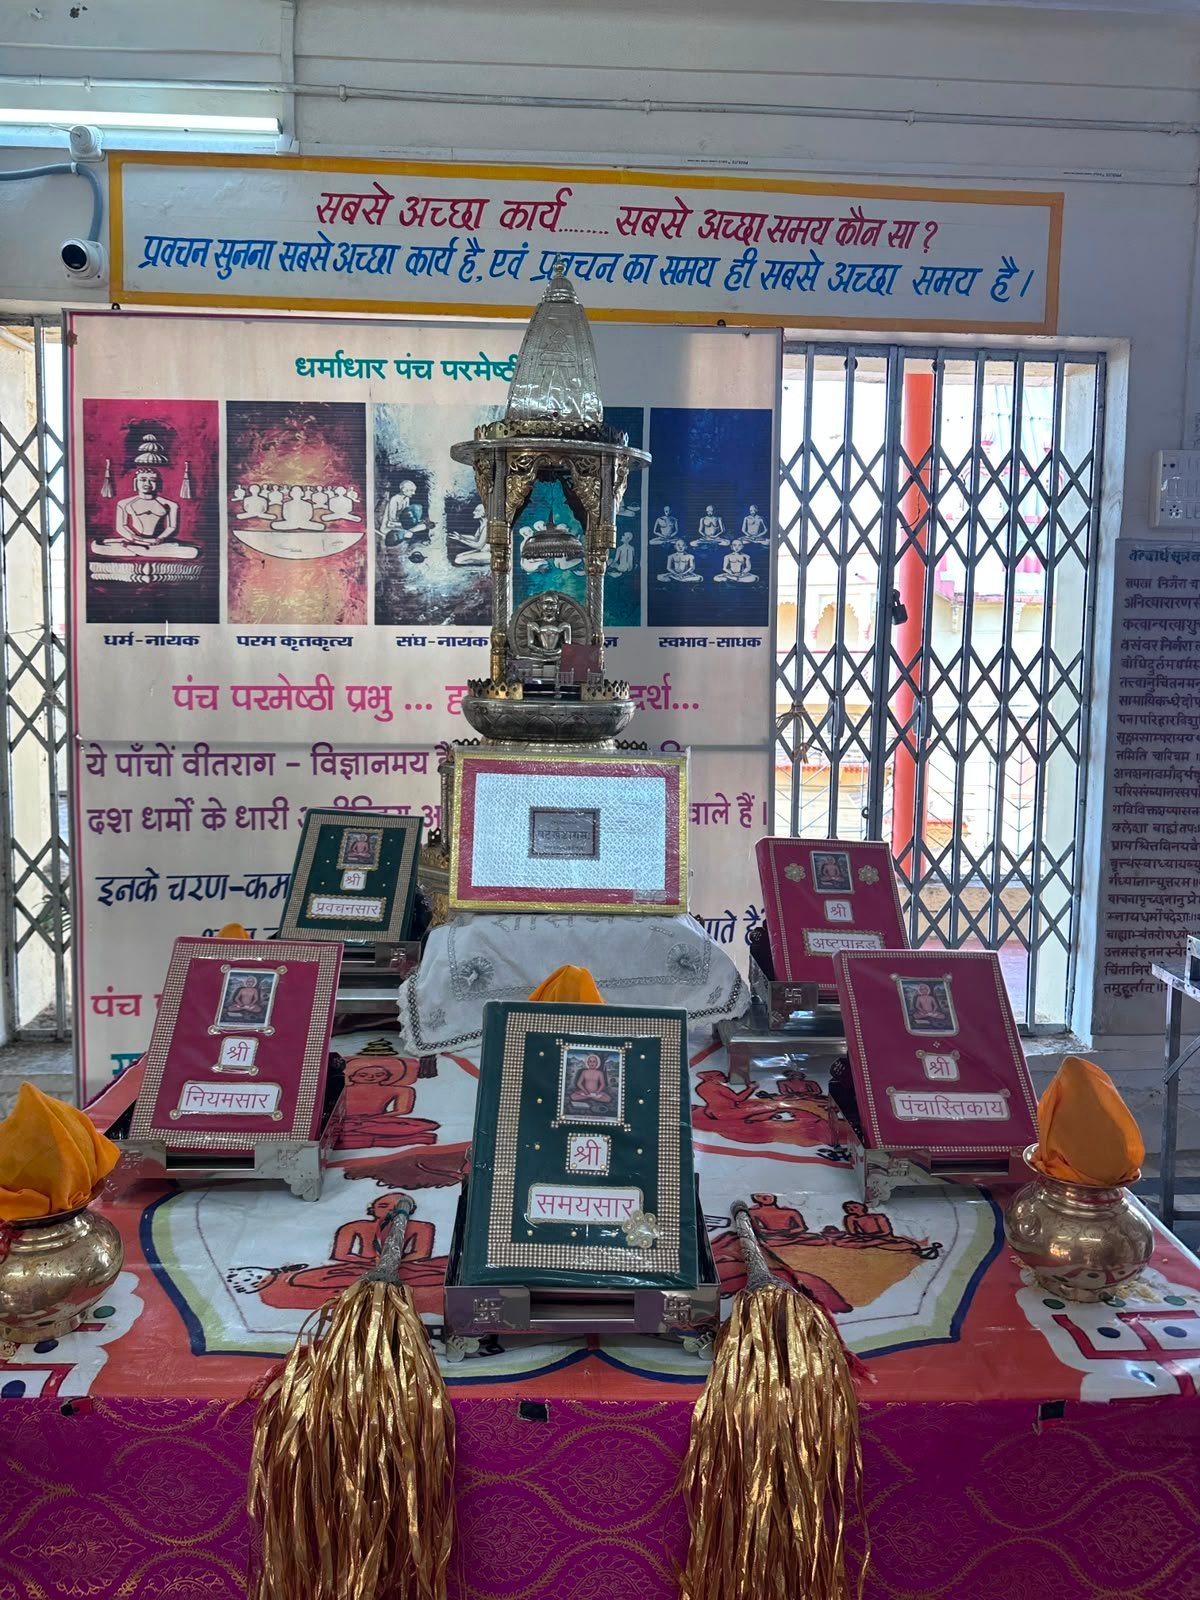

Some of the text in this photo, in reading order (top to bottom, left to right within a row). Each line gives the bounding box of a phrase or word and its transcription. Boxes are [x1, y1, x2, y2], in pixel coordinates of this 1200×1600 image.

[316, 181, 395, 226] सबसे
[399, 195, 491, 232] अच्छा
[615, 195, 694, 240] सबसे
[698, 208, 769, 246] अच्छा
[767, 214, 835, 247] समय
[836, 205, 888, 248] कौन
[137, 235, 214, 269] प्रवचन
[213, 238, 278, 281] सुनना
[278, 230, 337, 273] सबसे
[333, 242, 402, 275] अच्छा
[405, 237, 460, 277] कार्य
[489, 241, 530, 280] एवं
[622, 253, 658, 285] का
[659, 255, 721, 288] समय
[723, 246, 758, 292] ही
[760, 248, 825, 293] सबसे
[827, 261, 903, 296] अच्छा
[912, 265, 983, 297] समय
[294, 349, 389, 379] धर्माधार
[393, 352, 435, 380] पंच
[236, 635, 354, 652] परम कृतकृत्य
[171, 674, 219, 711] पंच
[230, 673, 335, 712] परमेष्ठी
[345, 685, 394, 723] प्रभु
[86, 742, 108, 778] ये
[115, 741, 176, 777] पाँचों
[182, 741, 277, 777] वीतराग
[310, 741, 430, 781] विज्ञानमय
[86, 807, 133, 835] दश
[141, 796, 195, 832] धर्मों
[200, 796, 227, 832] के
[235, 795, 290, 831] धारी
[95, 866, 292, 907] इनके चरण-कम
[344, 872, 362, 887] श्री
[315, 902, 379, 915] प्रवचनसार
[830, 902, 848, 918] श्री
[90, 985, 143, 1018] पंच
[226, 1041, 251, 1062] श्री
[929, 1056, 950, 1076] श्री
[185, 1085, 271, 1109] नियमसार
[899, 1094, 1003, 1116] पंचास्तिकाय
[574, 1139, 602, 1166] श्री
[535, 1193, 636, 1218] समयसार
